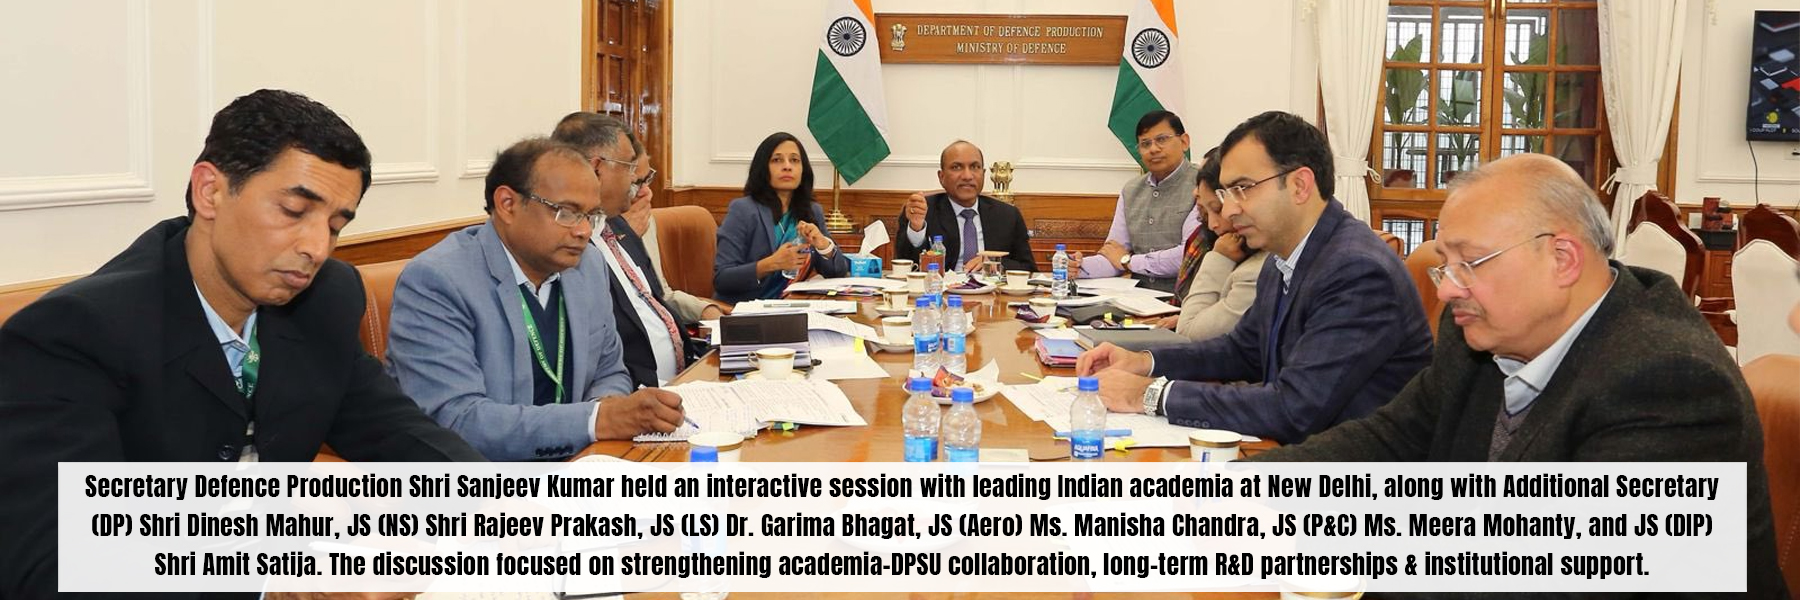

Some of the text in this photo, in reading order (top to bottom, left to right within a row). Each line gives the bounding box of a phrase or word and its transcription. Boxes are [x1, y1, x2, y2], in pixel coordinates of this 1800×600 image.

[917, 24, 1104, 38] DEPARTMENT OF DEFENCE PRODUCTION
[957, 42, 1066, 54] MINISTRY OF DEFENCE
